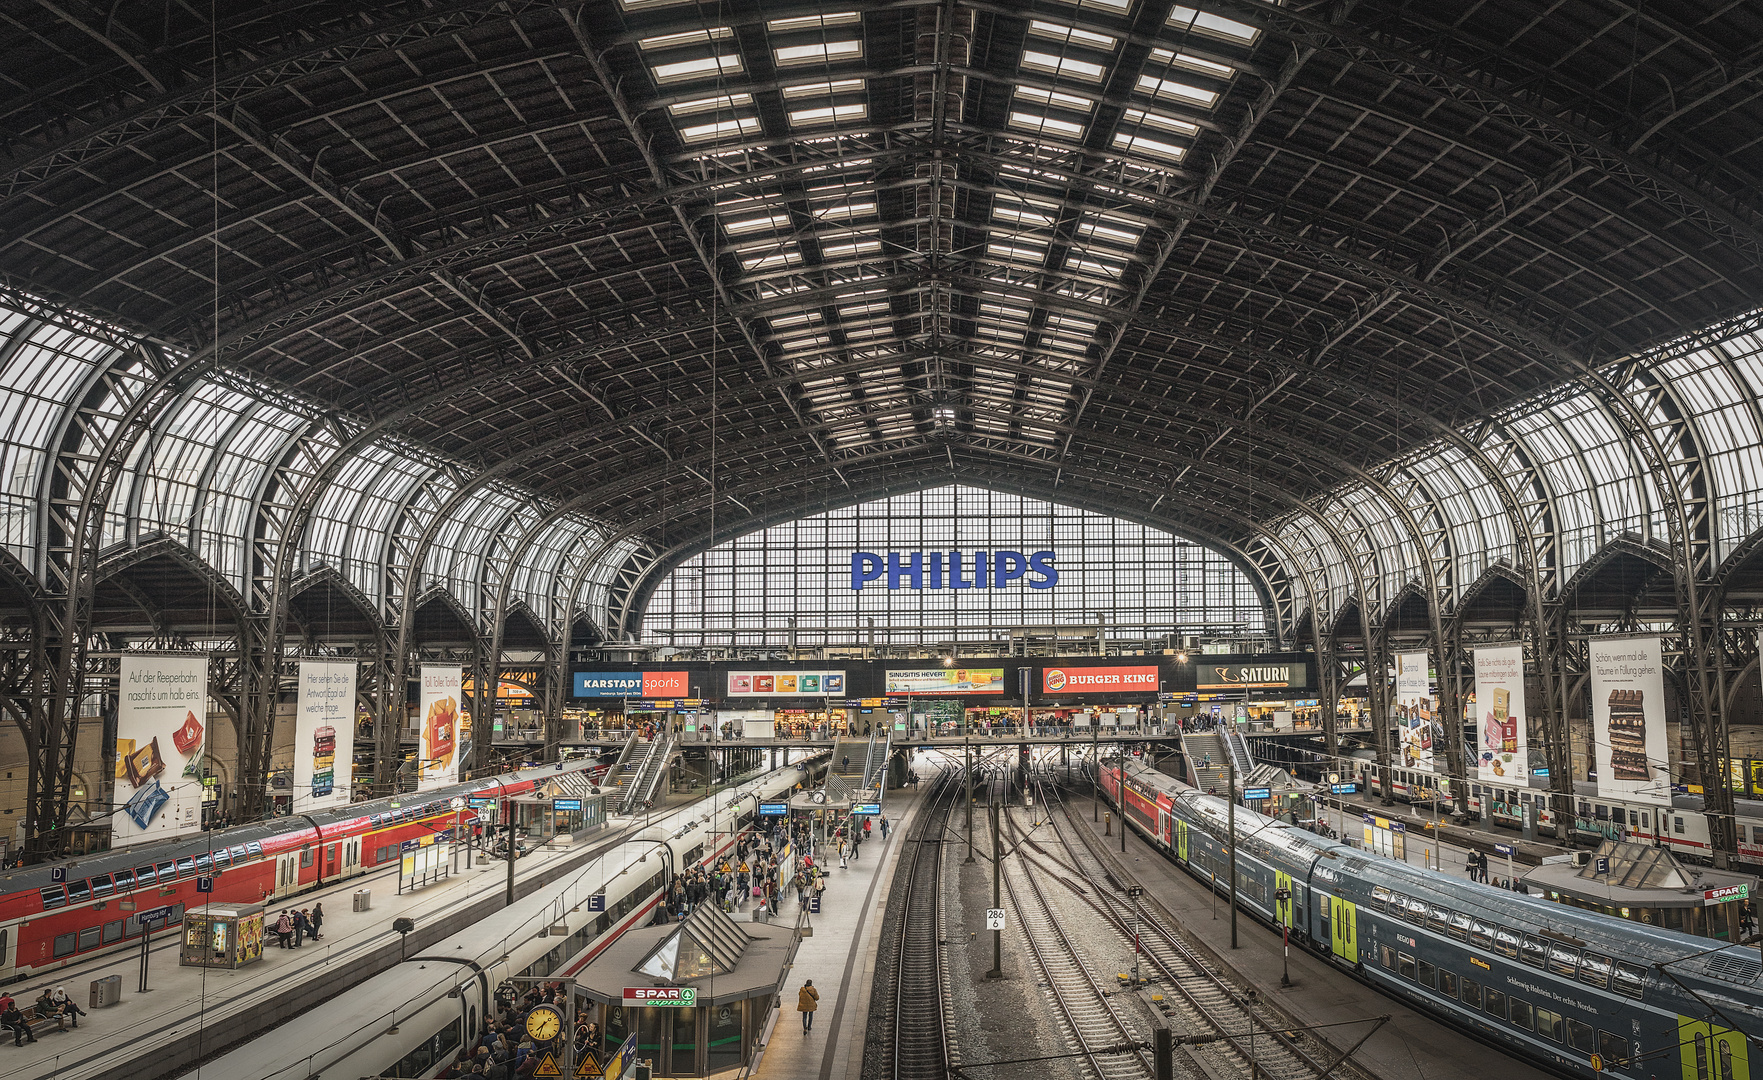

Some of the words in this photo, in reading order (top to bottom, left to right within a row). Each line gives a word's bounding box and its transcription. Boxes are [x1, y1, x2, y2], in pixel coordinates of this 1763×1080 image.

[852, 551, 1059, 590] PHILIPS
[1596, 652, 1612, 662] Schön,
[1627, 650, 1636, 661] mal
[1638, 650, 1648, 660] alle
[1241, 667, 1289, 682] SATURN
[1596, 666, 1613, 675] Träume
[1620, 664, 1637, 677] Füllung
[1638, 664, 1656, 677] gehen.
[129, 670, 142, 683] Auf
[143, 670, 156, 683] der
[157, 670, 197, 686] Reeperbahn
[307, 673, 318, 683] Hier
[584, 680, 641, 688] KARSTADT
[645, 677, 679, 690] sports
[1049, 678, 1064, 686] KING
[1070, 675, 1120, 684] BURGER
[1124, 674, 1155, 683] KING
[158, 692, 168, 700] um
[170, 688, 184, 700] halb
[186, 690, 200, 700] eins.
[1598, 860, 1604, 871] E
[53, 868, 61, 879] D
[201, 879, 210, 889] D
[1712, 887, 1738, 897] SPAR
[590, 896, 598, 908] E
[810, 898, 818, 909] E
[142, 912, 159, 920] Hamburg
[988, 910, 1004, 919] 286
[1396, 934, 1410, 944] REGIO
[41, 942, 46, 950] 2
[636, 990, 678, 998] SPAR
[1506, 976, 1552, 998] Schleswig-Holstein.
[1553, 992, 1562, 1002] Der
[1563, 996, 1576, 1006] echte
[1577, 1000, 1598, 1015] Norden.
